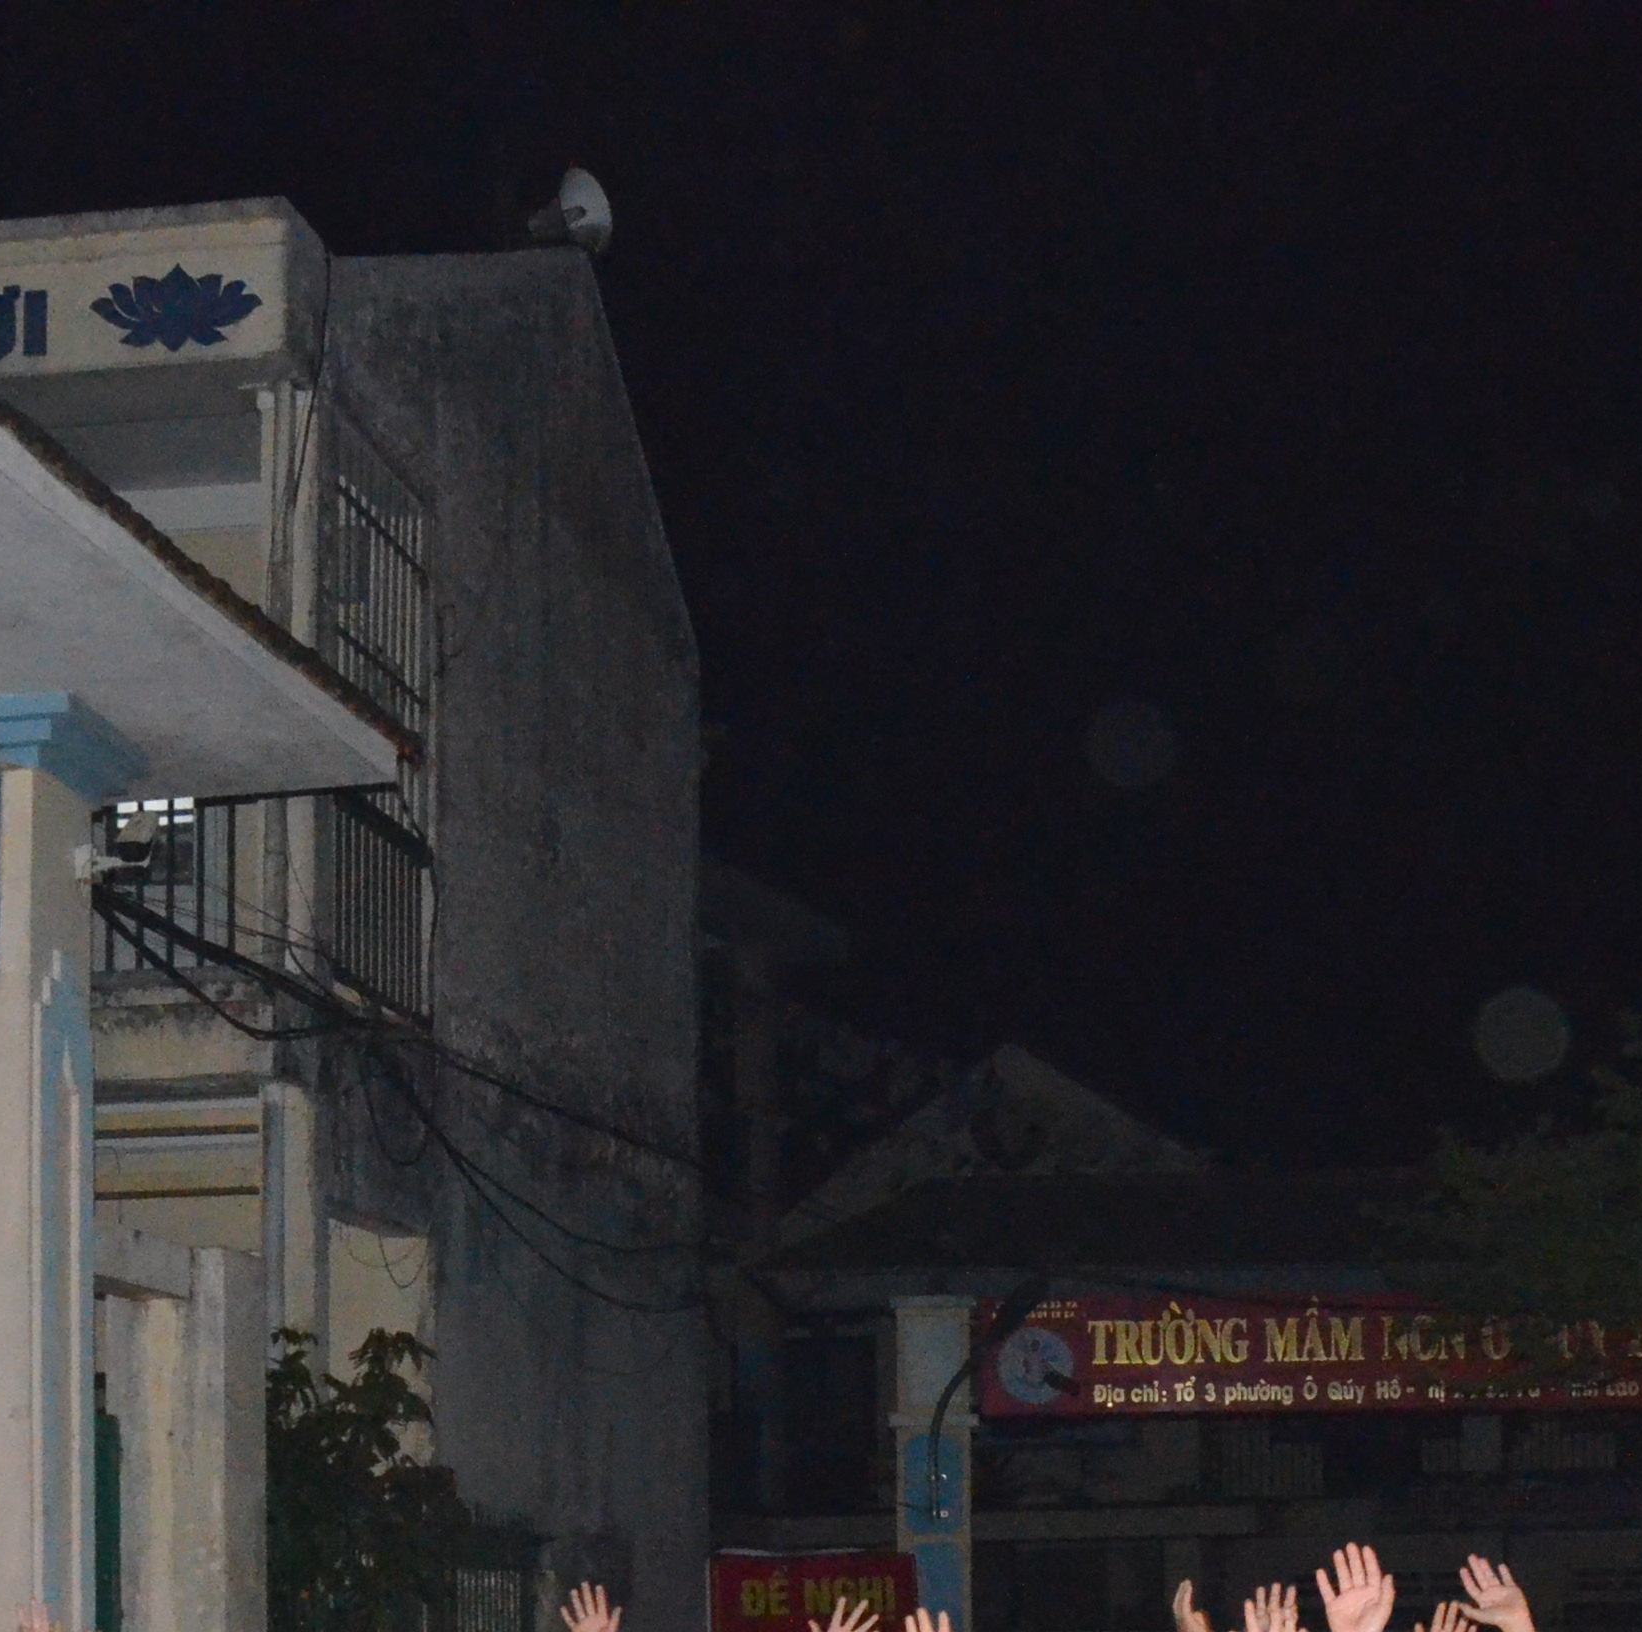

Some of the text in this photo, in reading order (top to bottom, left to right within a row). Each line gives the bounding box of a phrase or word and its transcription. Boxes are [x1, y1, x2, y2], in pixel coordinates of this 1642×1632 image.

[1086, 1300, 1251, 1367] TRƯỜNG
[1263, 1297, 1366, 1364] MẦM
[1093, 1383, 1126, 1408] Địa
[1173, 1374, 1197, 1404] Tổ
[1204, 1382, 1217, 1403] 3
[1224, 1378, 1294, 1407] phường
[1303, 1374, 1319, 1402] Ô
